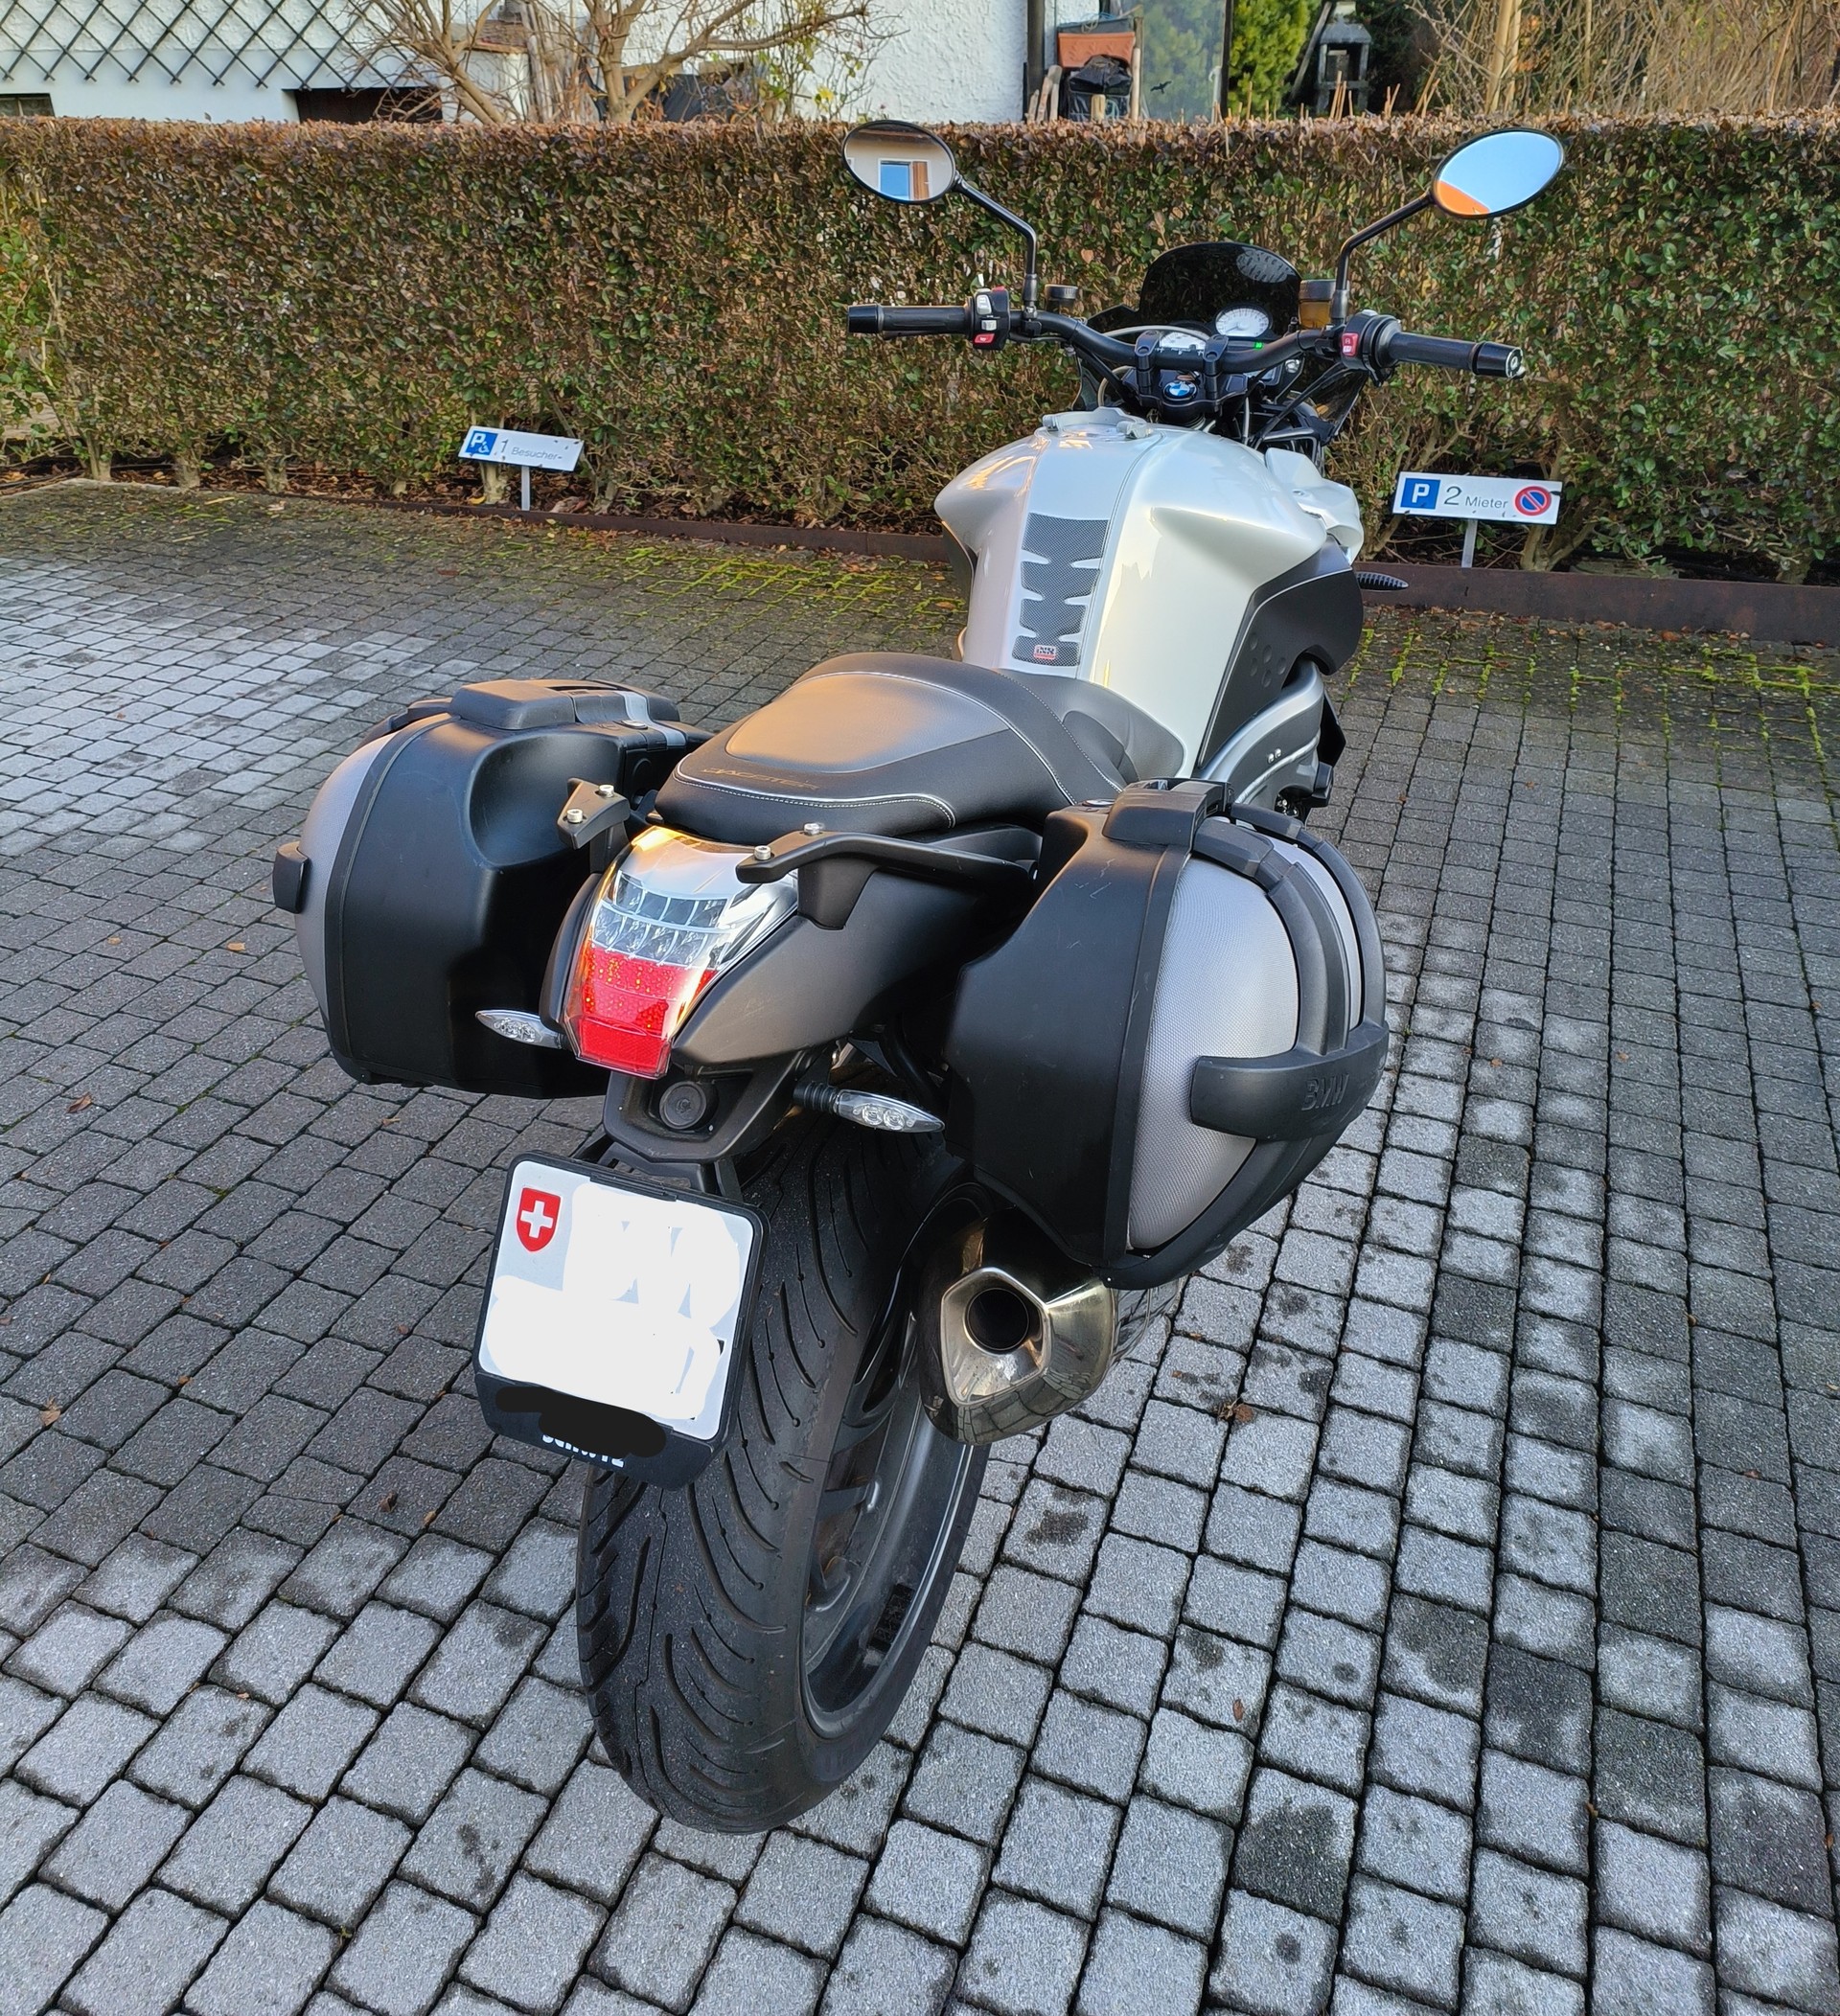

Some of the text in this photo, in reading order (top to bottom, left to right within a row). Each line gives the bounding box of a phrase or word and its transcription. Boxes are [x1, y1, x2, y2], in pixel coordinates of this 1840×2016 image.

[471, 433, 486, 447] P
[501, 439, 509, 453] 1
[1412, 483, 1508, 509] P 2 Mieter
[1300, 1073, 1349, 1111] BMW
